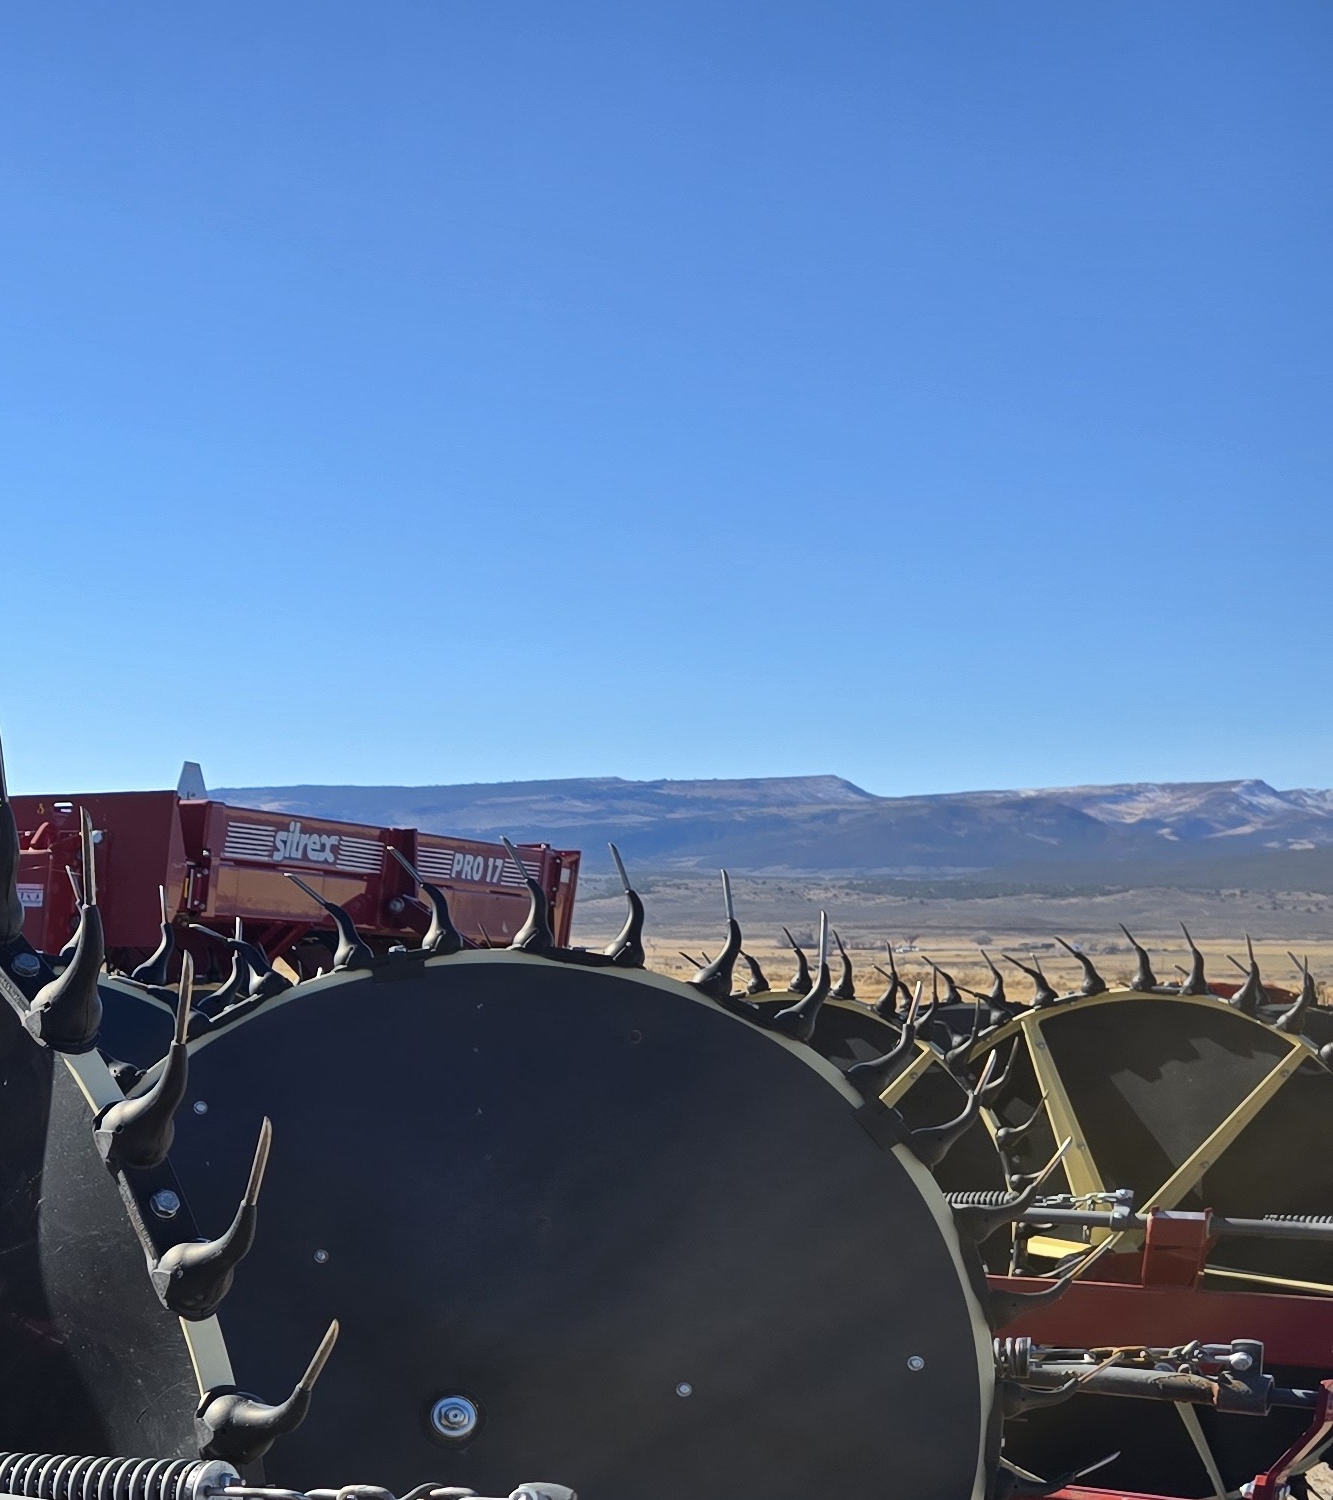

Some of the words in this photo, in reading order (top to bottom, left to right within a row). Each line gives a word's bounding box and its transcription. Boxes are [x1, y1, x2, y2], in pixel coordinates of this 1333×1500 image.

[271, 820, 339, 863] sitrex
[450, 852, 483, 881] PRO
[486, 856, 504, 883] 17
